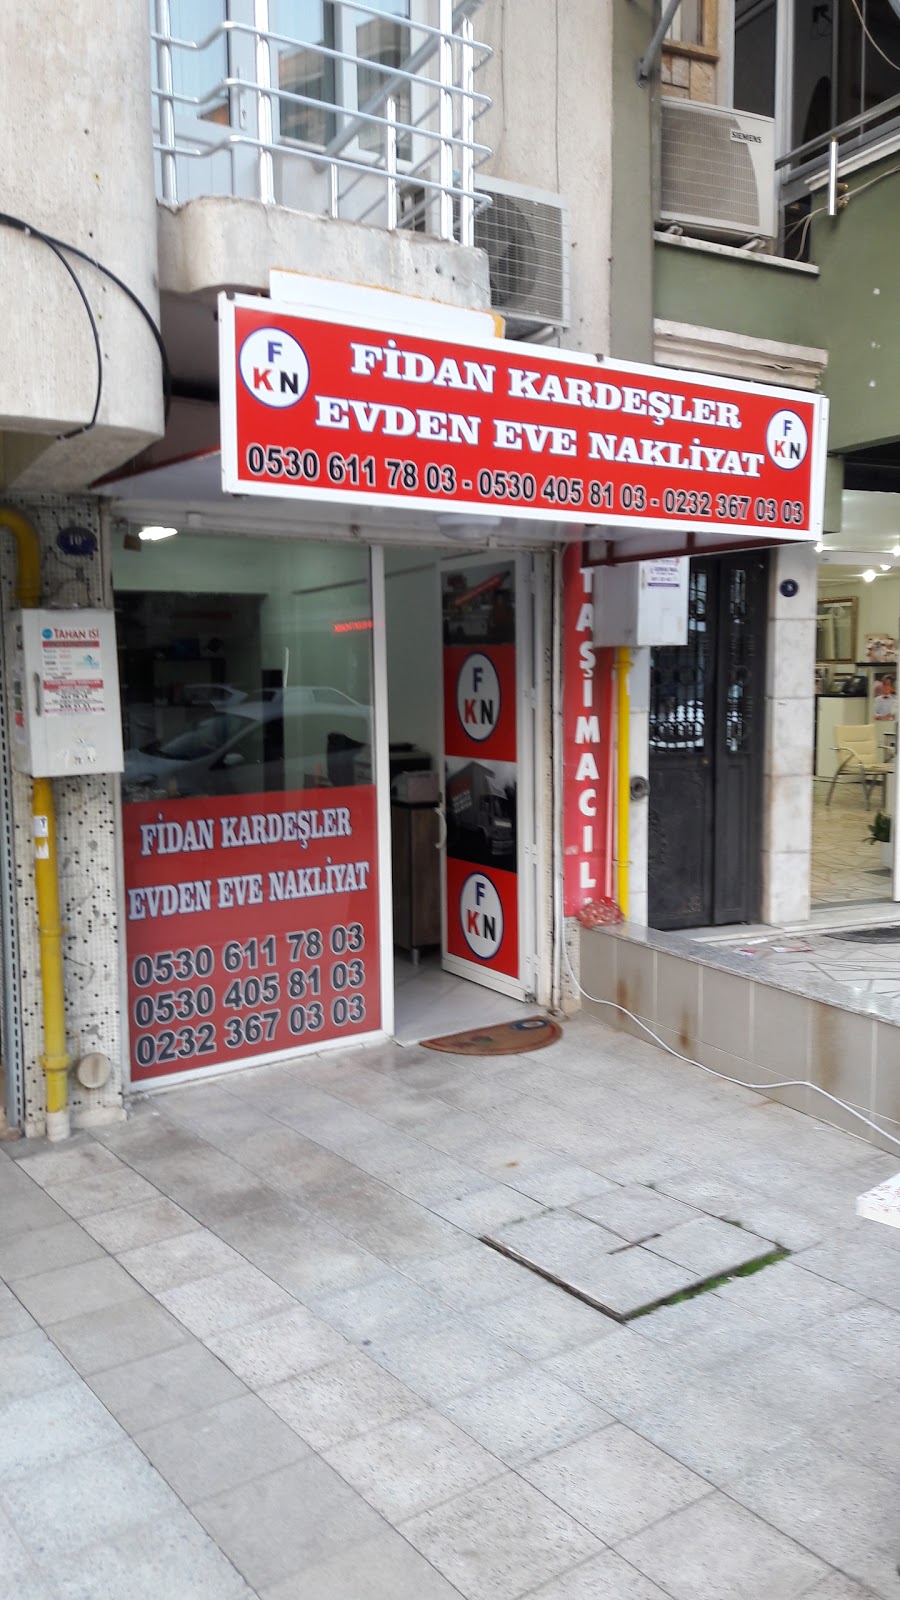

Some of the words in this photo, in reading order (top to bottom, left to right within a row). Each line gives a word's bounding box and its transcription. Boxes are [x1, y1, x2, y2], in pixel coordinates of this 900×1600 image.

[732, 131, 761, 143] SIEMENS
[268, 341, 282, 362] F
[350, 338, 496, 394] FİDAN
[508, 367, 742, 429] KARDEŞLER
[314, 395, 481, 445] EVDEN
[493, 419, 577, 458] EVE
[588, 437, 765, 478] NAKLİYAT
[783, 420, 793, 437] F
[247, 443, 320, 480] 0530
[328, 453, 377, 487] 611
[385, 460, 418, 490] 78
[425, 465, 457, 493] 03
[477, 470, 535, 501] 0530
[541, 475, 583, 505] 405
[588, 480, 614, 508] 81
[621, 484, 647, 511] 03
[663, 488, 711, 516] 0232
[716, 494, 751, 520] 367
[755, 498, 778, 522] 03
[781, 501, 804, 525] 03
[473, 667, 483, 692] F
[574, 567, 601, 905] TAŞIMACIL
[140, 812, 215, 856] FİDAN
[220, 807, 352, 849] KARDEŞLER
[128, 880, 212, 921] EVDEN
[218, 873, 264, 909] EVE
[268, 856, 370, 902] NAKLİYAT
[475, 881, 486, 906] F
[133, 945, 214, 988] 0530
[222, 935, 277, 973] 611
[286, 928, 323, 962] 78
[330, 922, 365, 955] 03
[134, 985, 216, 1028] 0530
[223, 972, 280, 1012] 405
[287, 966, 321, 999] 81
[330, 958, 365, 992] 03
[135, 1024, 217, 1067] 0232
[223, 1009, 280, 1048] 367
[287, 1001, 324, 1036] 03
[331, 994, 366, 1027] 03
